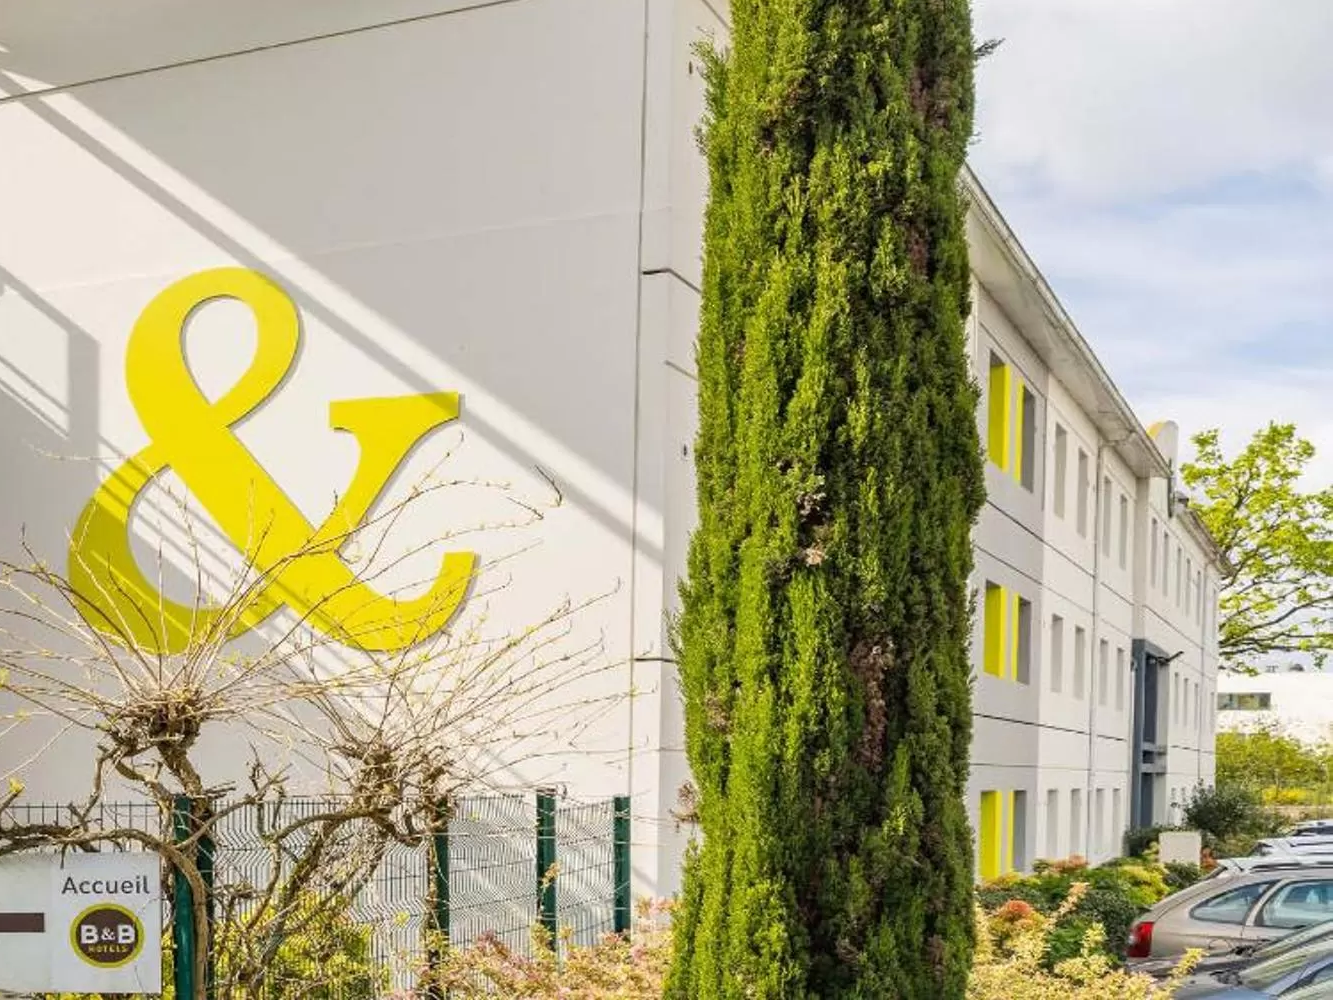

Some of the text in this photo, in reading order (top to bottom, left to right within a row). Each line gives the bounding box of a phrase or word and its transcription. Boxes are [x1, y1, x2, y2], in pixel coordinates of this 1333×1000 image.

[61, 875, 150, 894] Accueil
[80, 924, 136, 944] B&B
[88, 944, 127, 953] HOTELS
